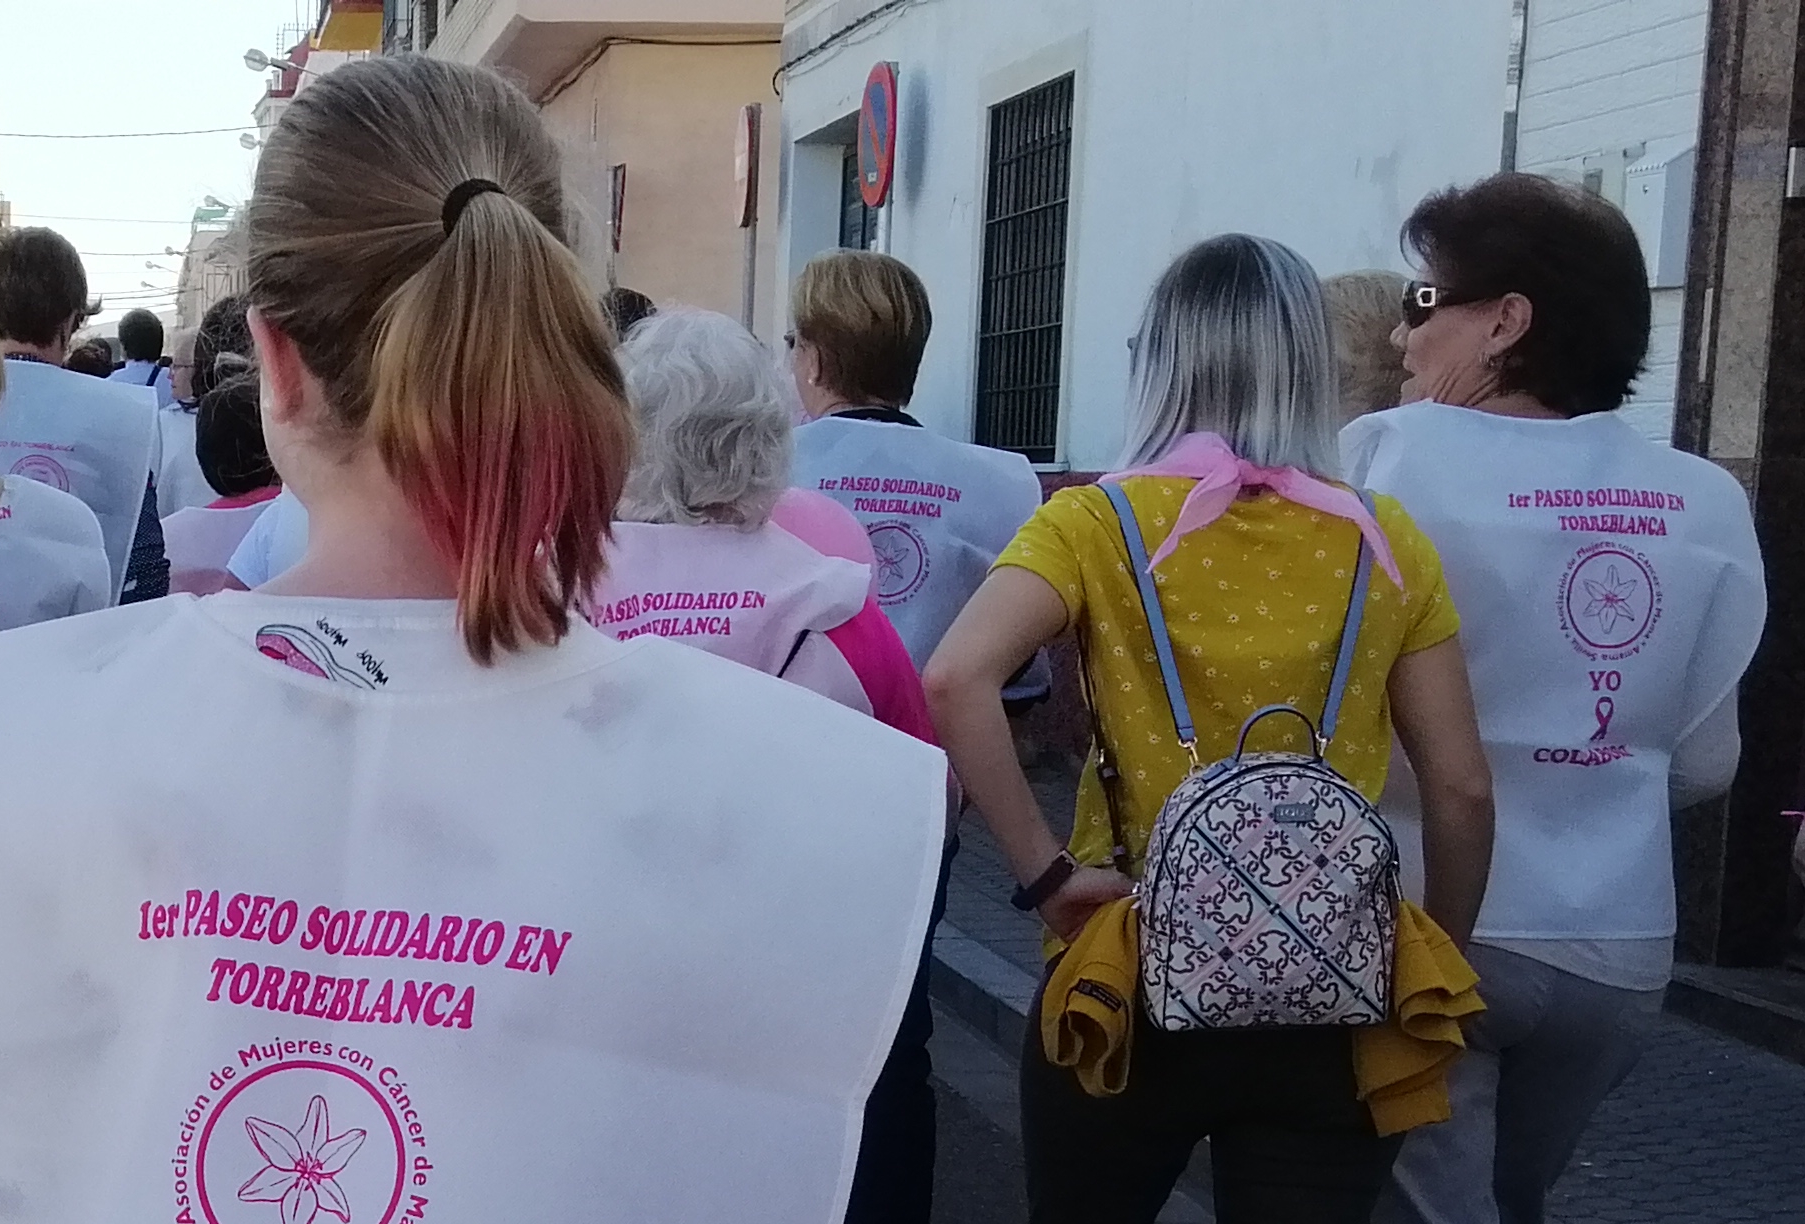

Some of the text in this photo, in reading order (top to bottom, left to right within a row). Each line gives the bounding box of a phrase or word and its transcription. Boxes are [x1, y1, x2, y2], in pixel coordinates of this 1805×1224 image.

[818, 477, 962, 502] 1er PASEO SOLIDARIO EN
[1508, 488, 1686, 512] 1er PASEO SOLIDARIO EN
[854, 498, 942, 518] TORREBLANCA
[1558, 515, 1668, 536] TORREBLANCA
[642, 592, 738, 614] SOLIDARIO
[740, 590, 767, 609] EN
[1588, 670, 1622, 691] YO
[138, 889, 572, 976] 1er PASEO SOLIDARIO EN
[206, 958, 475, 1029] TORREBLANCA
[171, 1093, 211, 1224] Asociación
[209, 1065, 237, 1091] de
[237, 1037, 333, 1067] Mujeres
[338, 1046, 374, 1072] con
[378, 1066, 427, 1148] Cáncer
[412, 1155, 434, 1186] de
